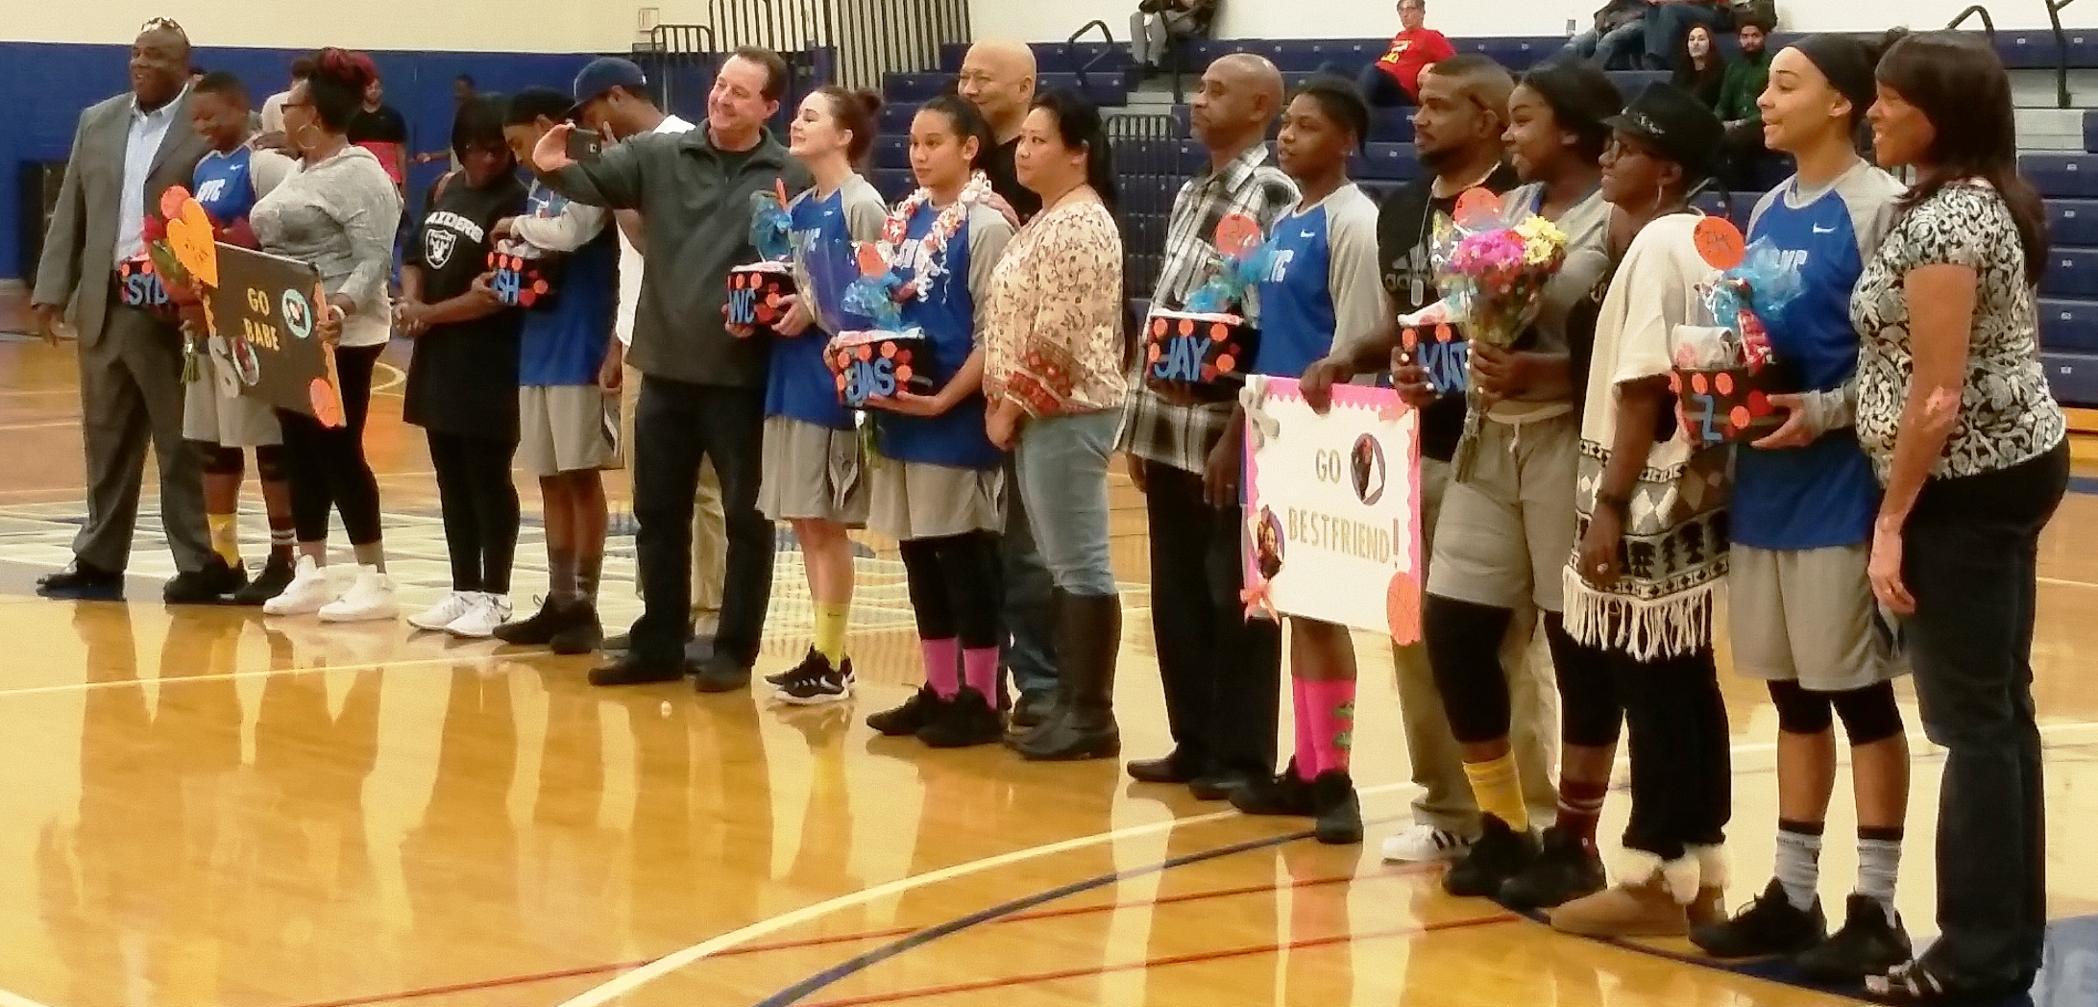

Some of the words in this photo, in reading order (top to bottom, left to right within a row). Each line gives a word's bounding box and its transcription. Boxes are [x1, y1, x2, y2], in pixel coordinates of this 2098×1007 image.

[424, 210, 484, 244] AIDERS
[247, 288, 270, 316] GO
[243, 317, 280, 351] BABE
[1155, 336, 1211, 381] JAY
[1315, 448, 1342, 484] GO
